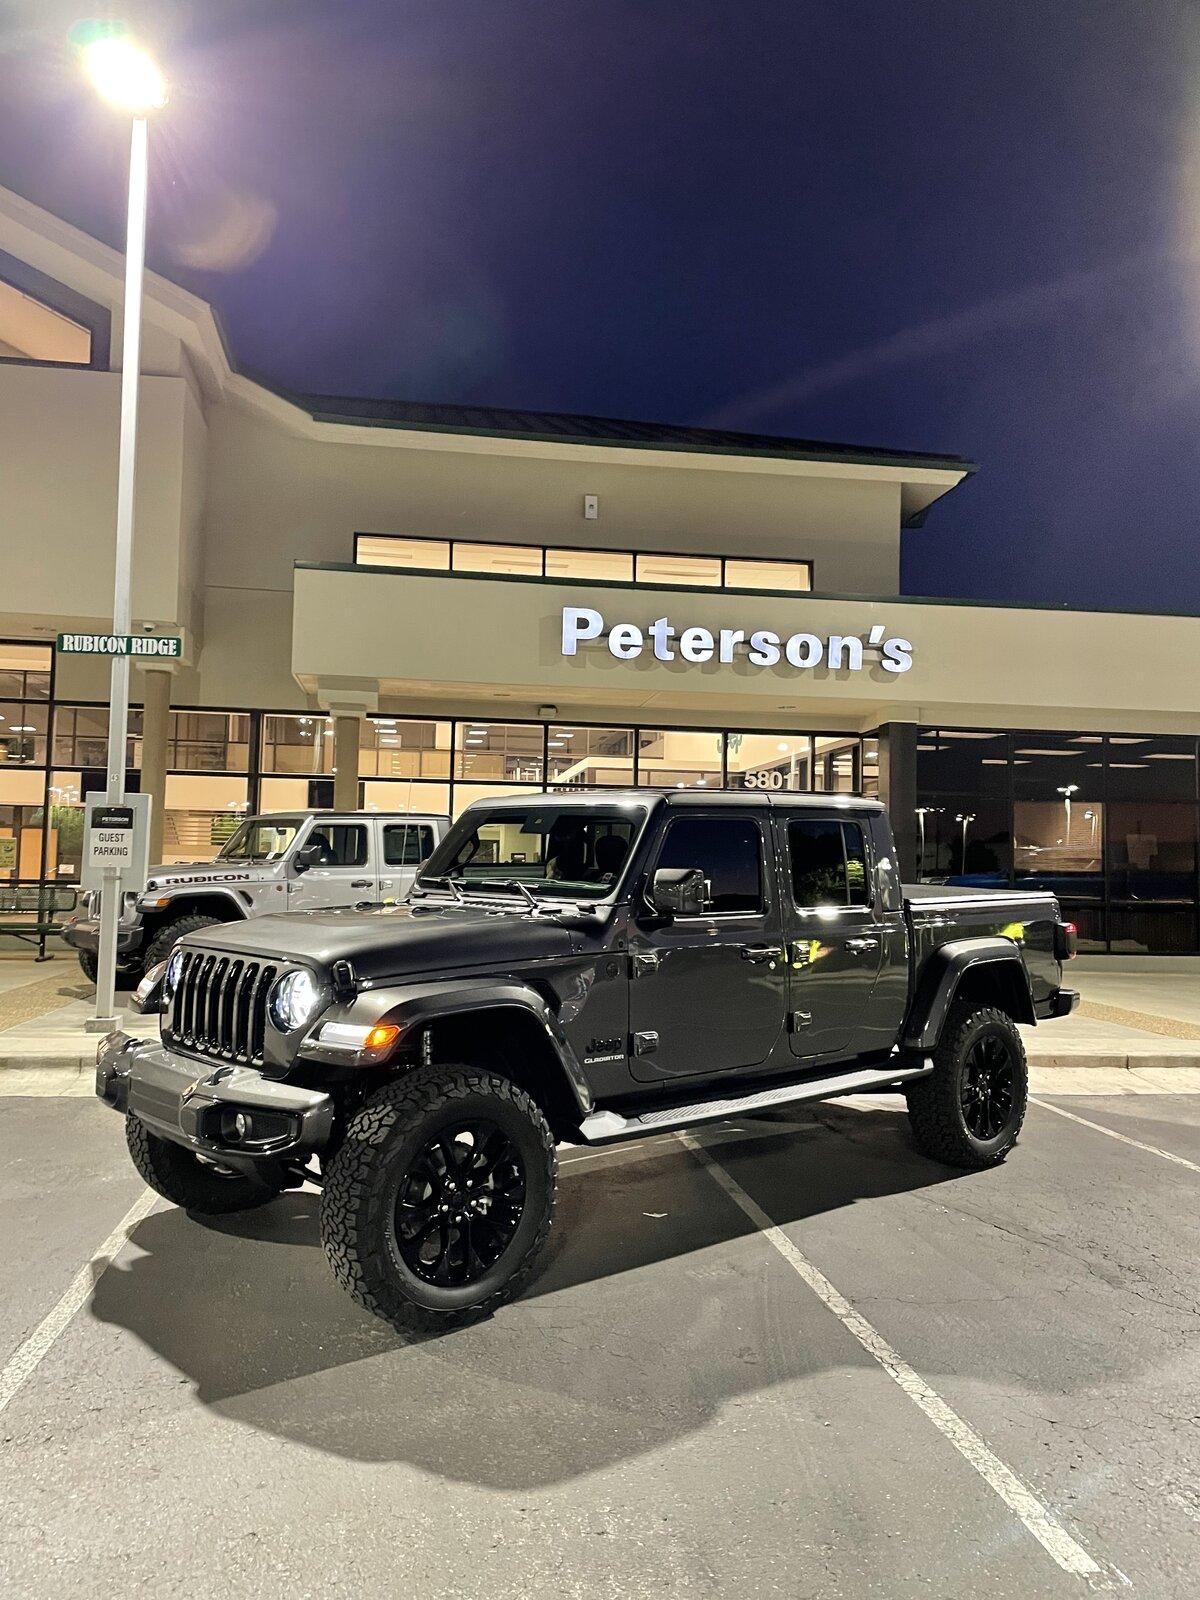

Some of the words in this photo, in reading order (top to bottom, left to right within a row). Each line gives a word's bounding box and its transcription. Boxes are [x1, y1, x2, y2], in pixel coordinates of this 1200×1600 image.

[62, 634, 127, 654] RUBICON
[130, 638, 177, 656] RIDGE
[561, 606, 913, 673] Peterson's
[98, 832, 125, 843] GUEST
[93, 846, 128, 857] PARKING
[165, 873, 250, 885] RUBICON
[583, 1053, 625, 1064] GLADIATOR
